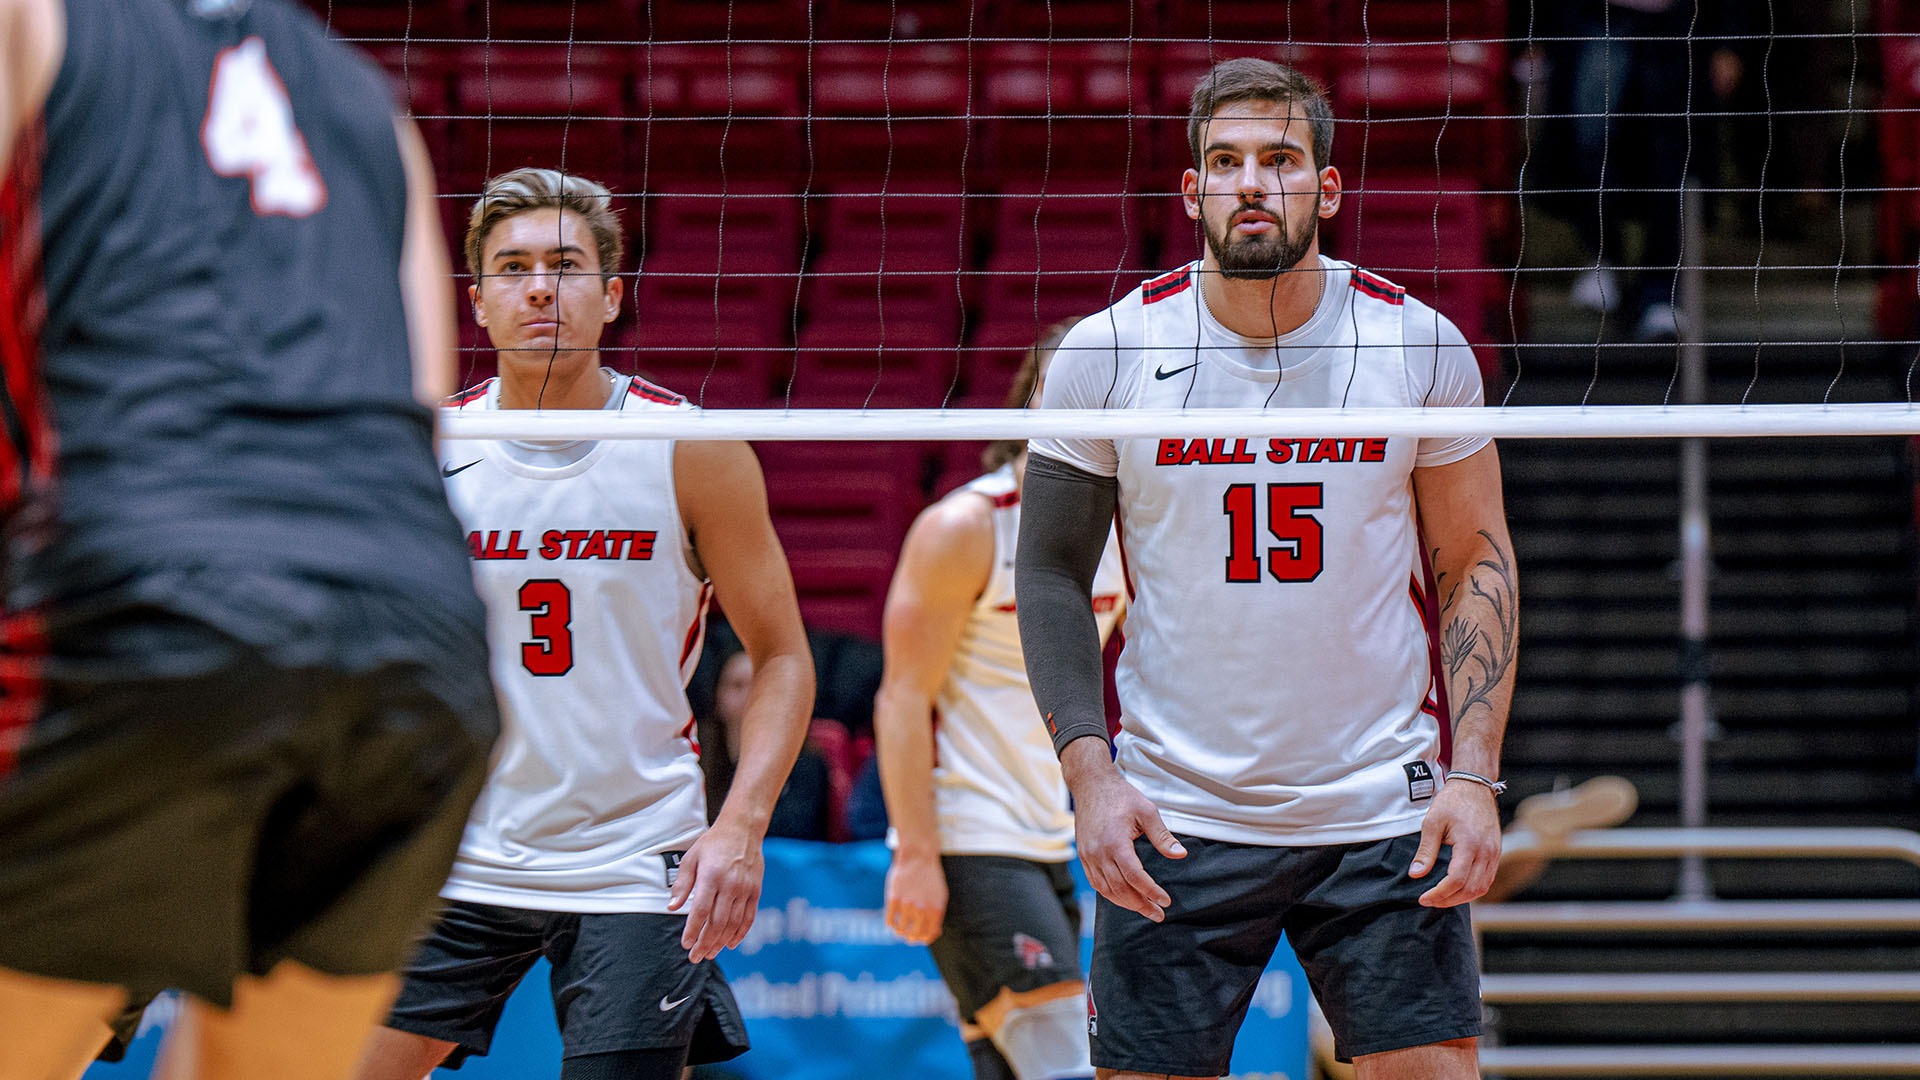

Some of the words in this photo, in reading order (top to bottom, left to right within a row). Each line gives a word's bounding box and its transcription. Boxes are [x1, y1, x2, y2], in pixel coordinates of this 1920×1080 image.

[201, 35, 328, 217] 4
[1156, 438, 1256, 466] BALL
[1266, 438, 1388, 463] STATE
[467, 530, 528, 560] ALL
[539, 529, 658, 560] STATE
[1223, 482, 1324, 583] 15
[518, 578, 574, 677] 3
[1412, 765, 1428, 777] XL
